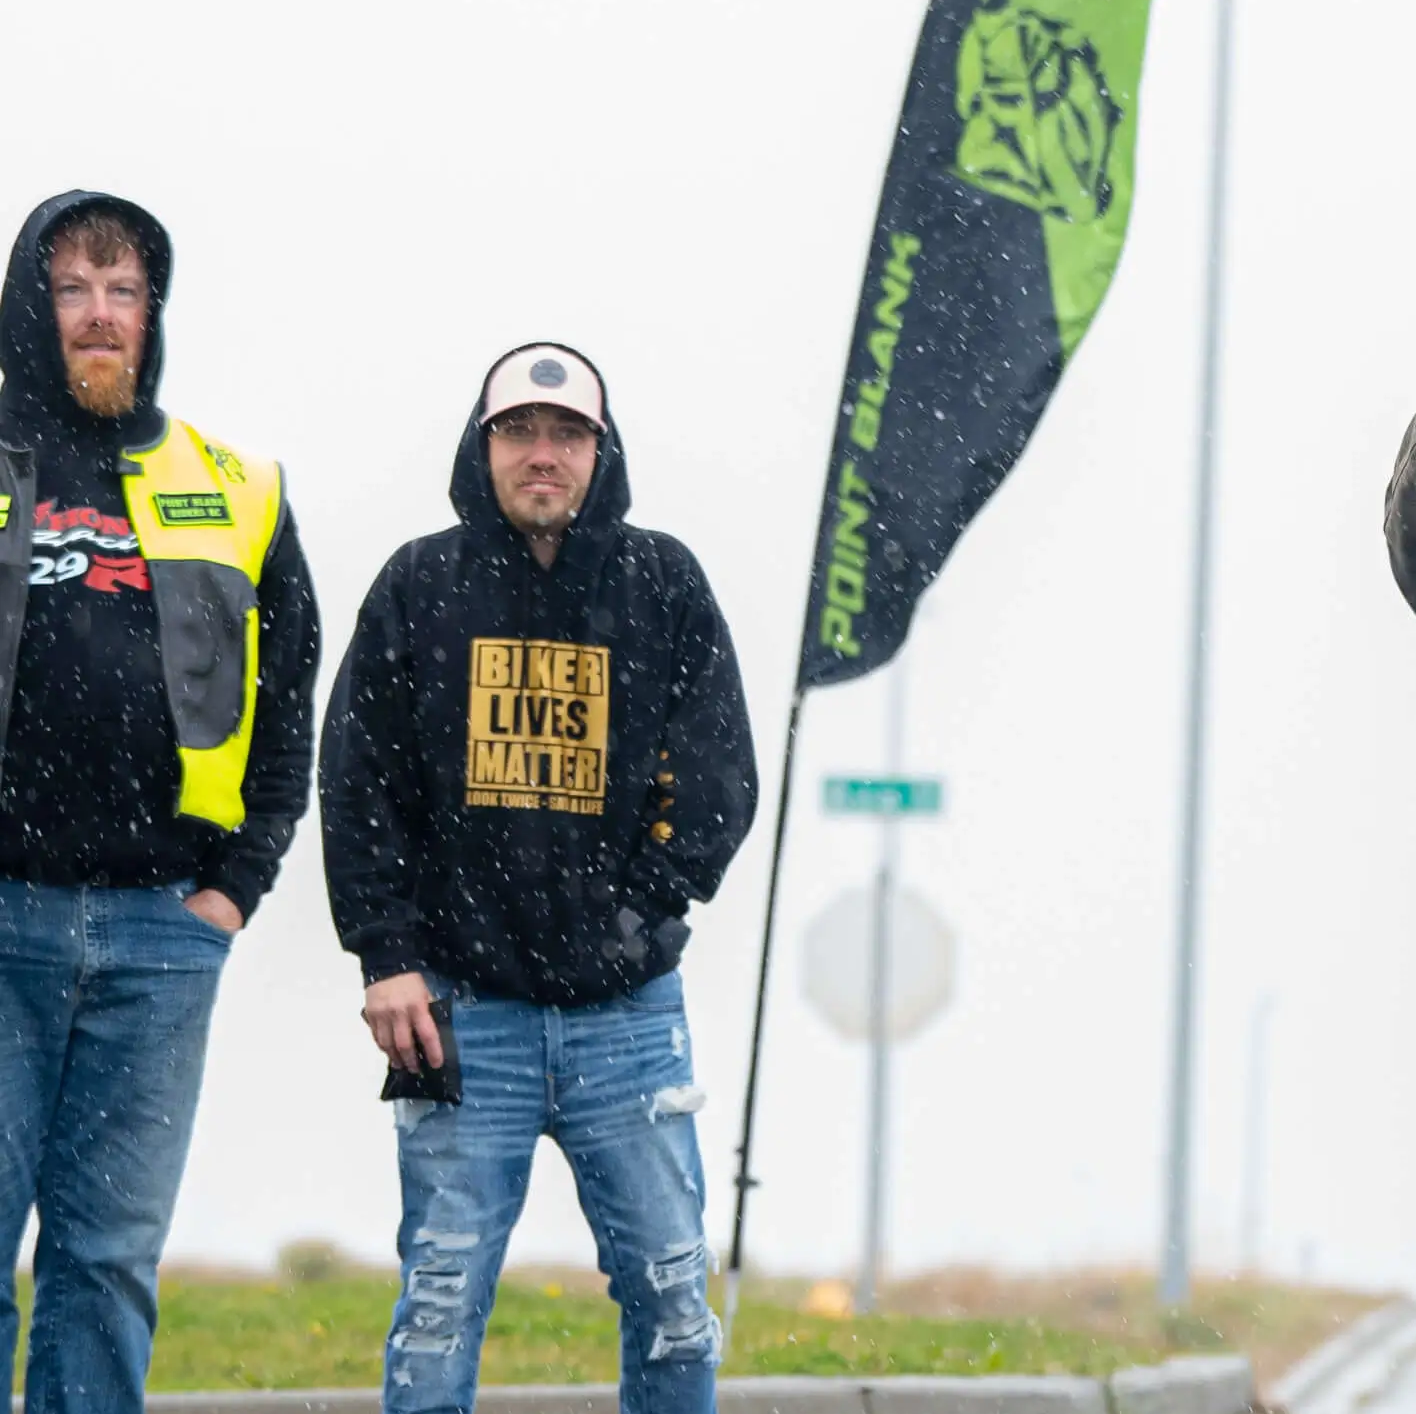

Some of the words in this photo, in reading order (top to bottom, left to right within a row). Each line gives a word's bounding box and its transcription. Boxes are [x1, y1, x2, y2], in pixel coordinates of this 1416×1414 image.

[820, 459, 872, 658] POINT
[850, 231, 922, 453] BLANK
[479, 644, 602, 696] BIKER
[489, 694, 589, 742] LIVES
[474, 740, 598, 792] MATTER
[466, 789, 499, 807] LOOK
